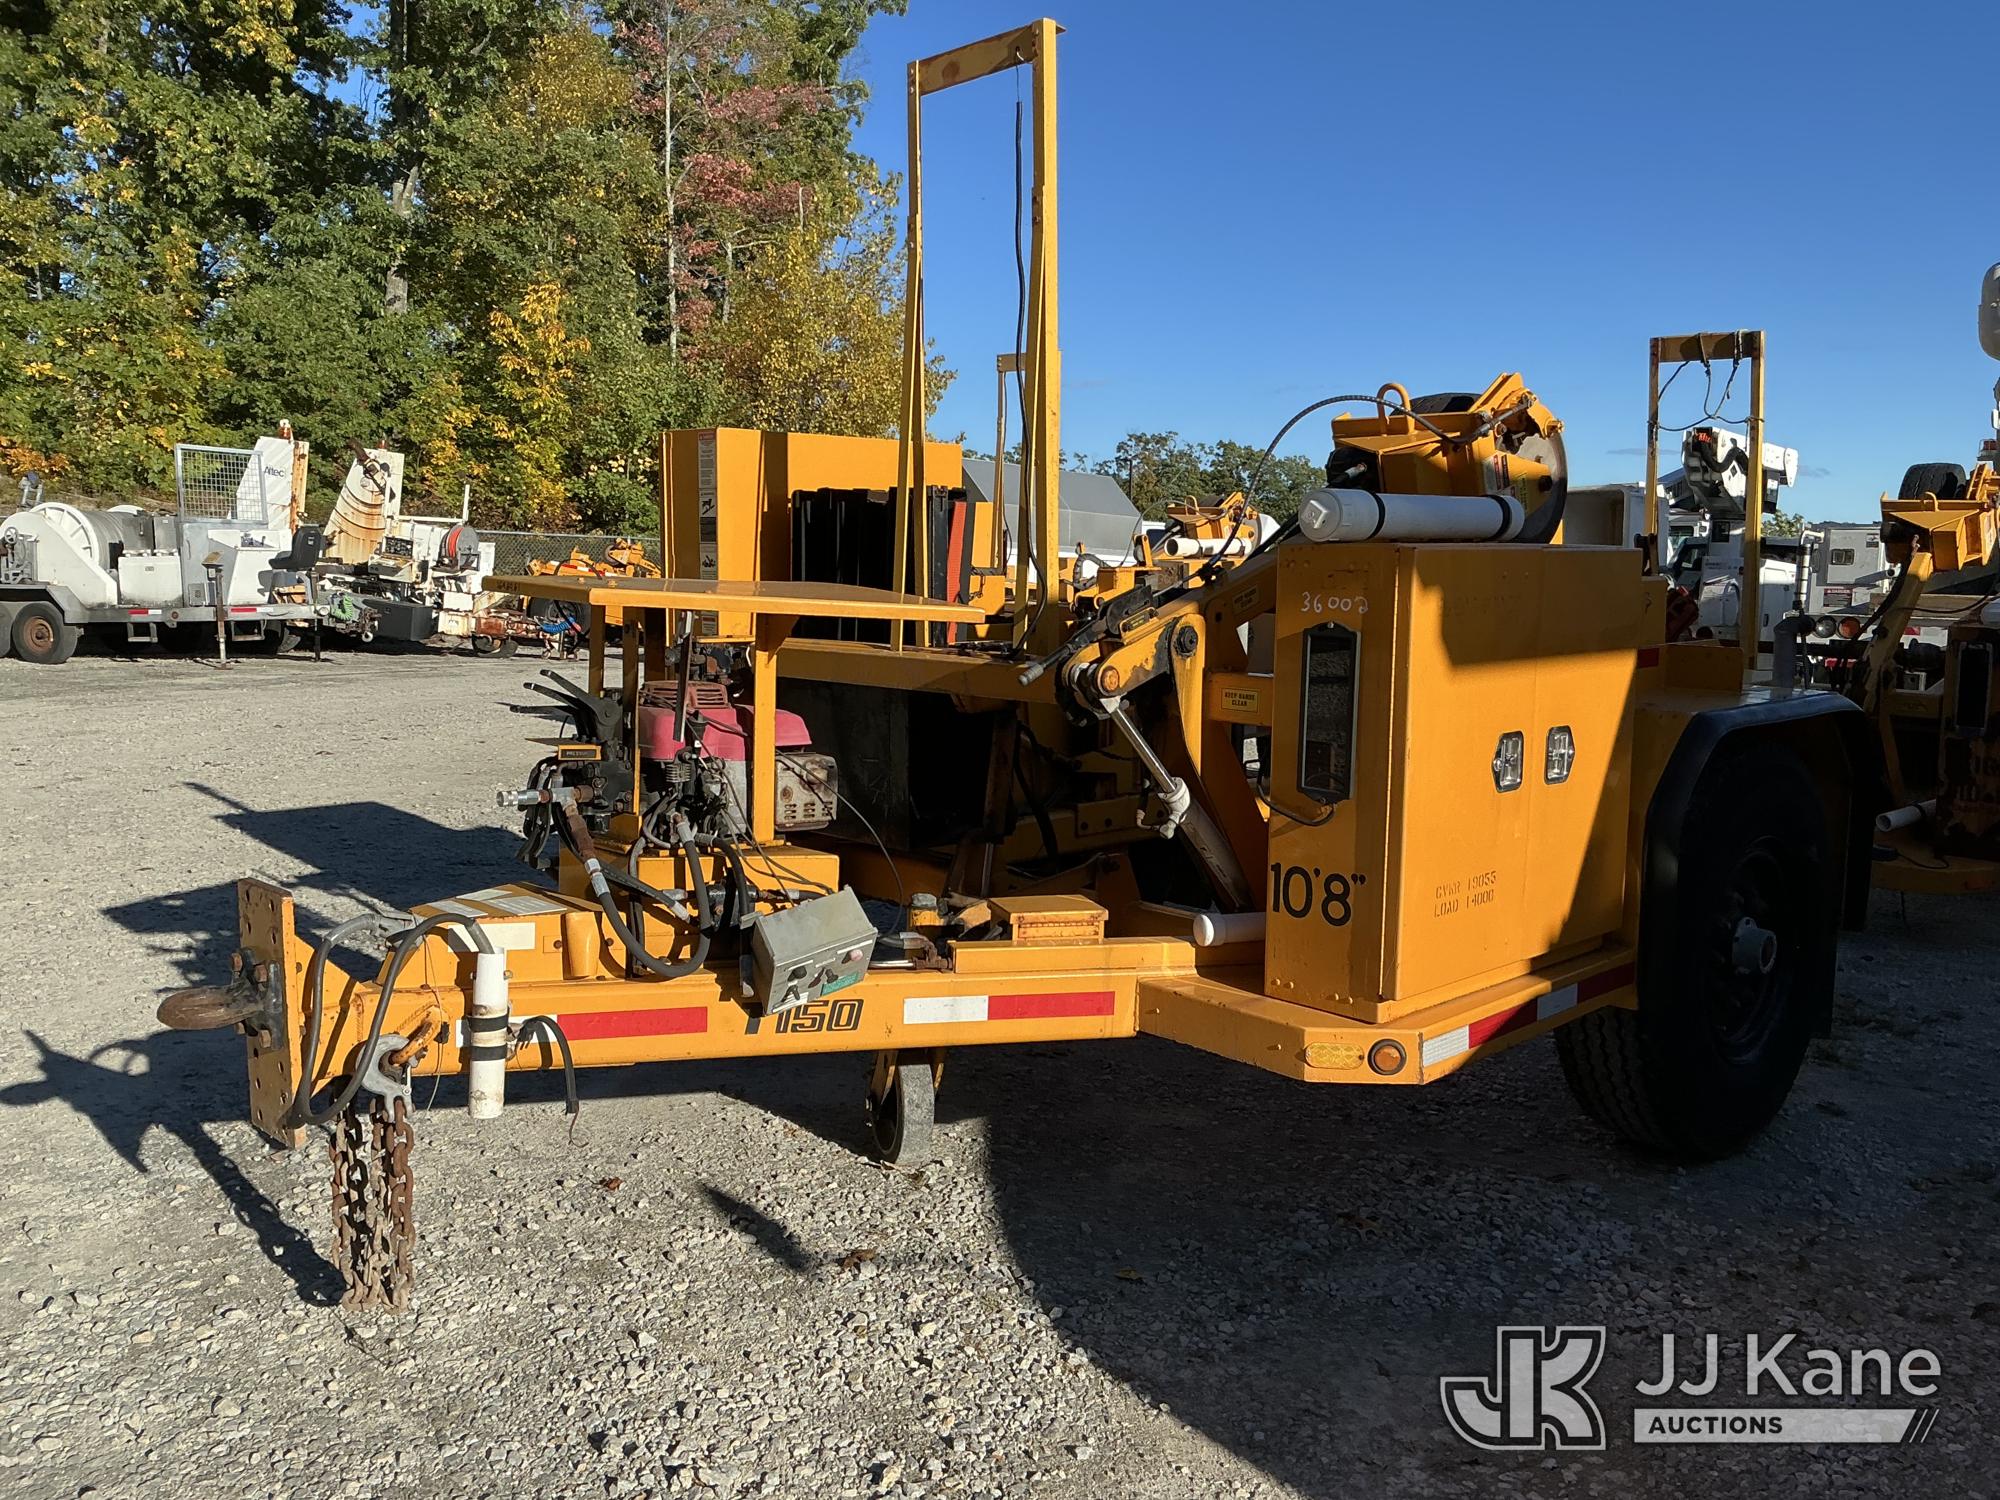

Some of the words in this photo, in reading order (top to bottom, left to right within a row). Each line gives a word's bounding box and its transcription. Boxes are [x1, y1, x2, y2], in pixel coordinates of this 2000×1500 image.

[1301, 591, 1369, 614] 36002
[1468, 870, 1496, 891] 19055
[1434, 899, 1459, 918] LOAD
[1466, 889, 1494, 910] 14000
